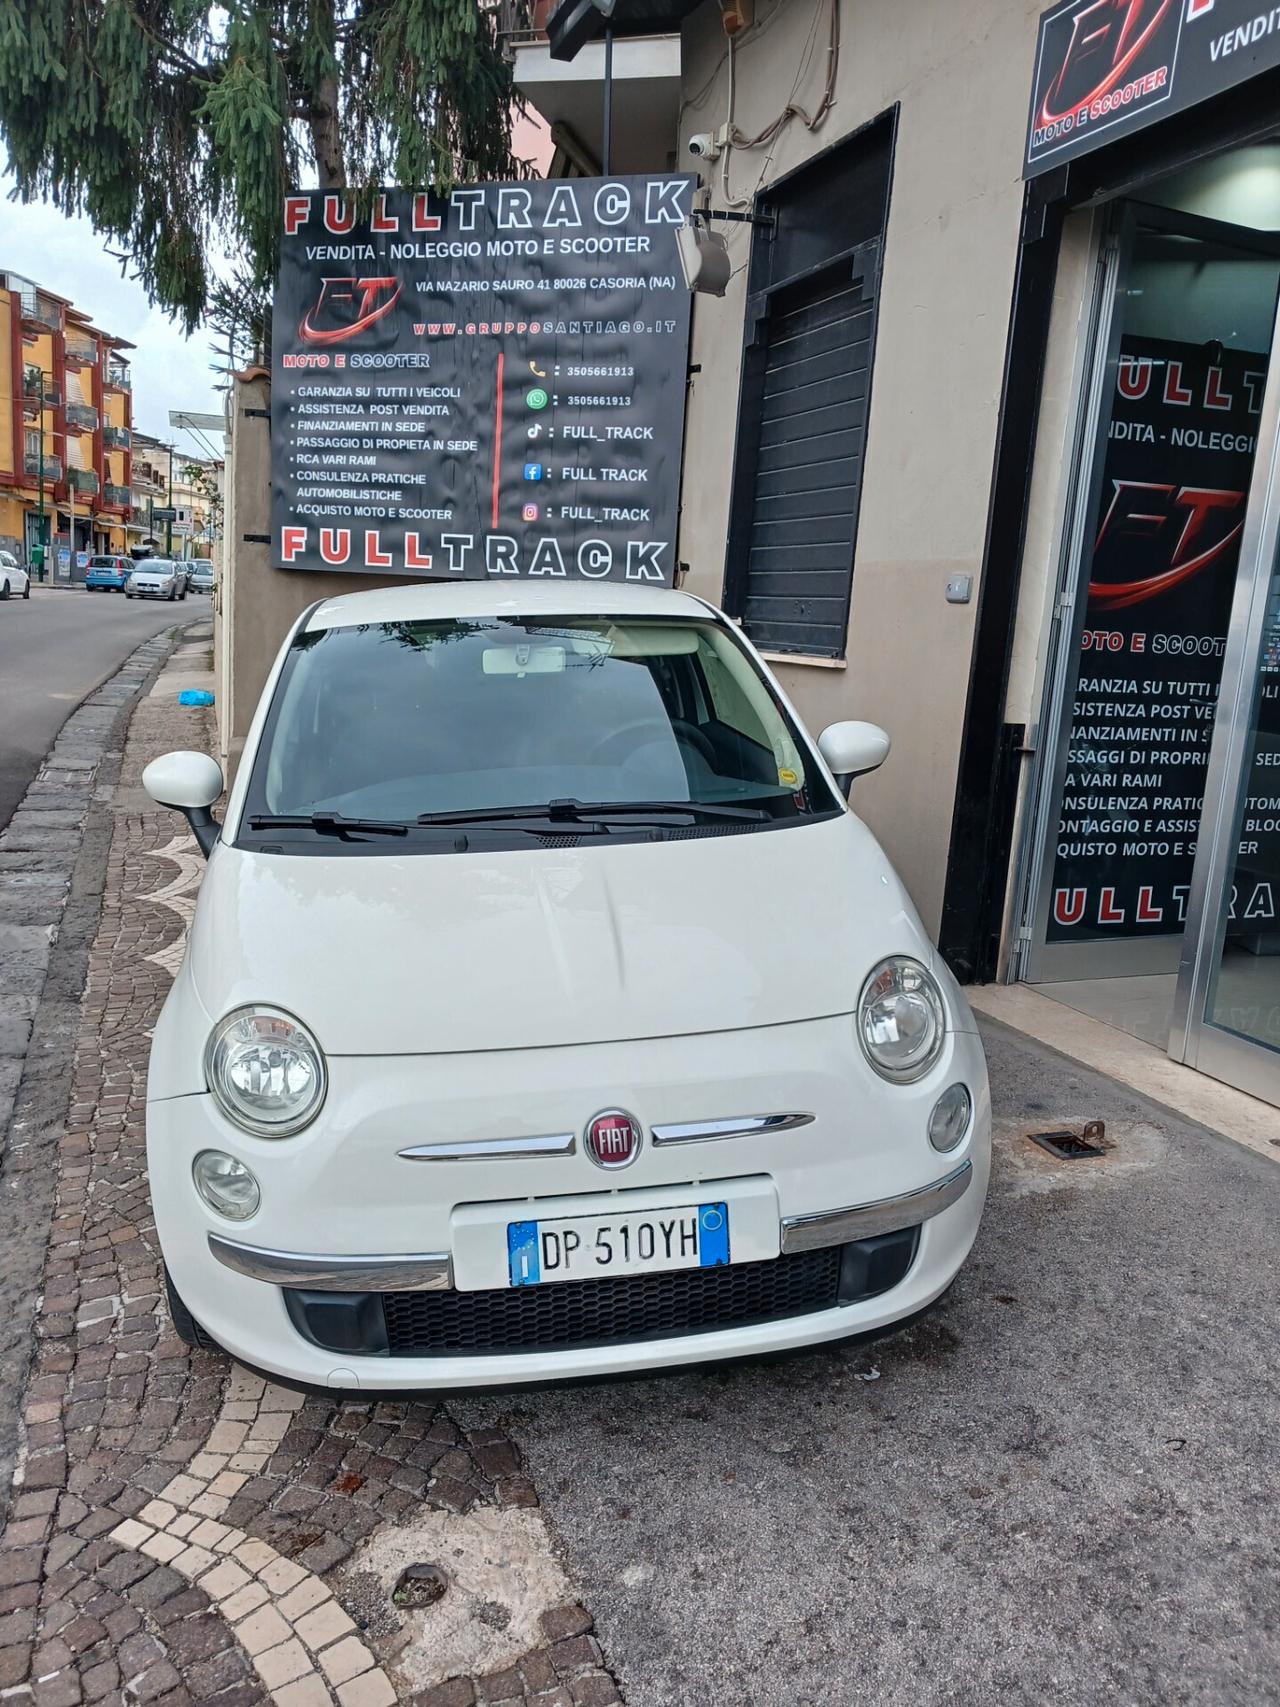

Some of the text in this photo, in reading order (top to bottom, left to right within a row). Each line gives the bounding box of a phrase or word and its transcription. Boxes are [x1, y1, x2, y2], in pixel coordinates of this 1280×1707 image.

[1033, 66, 1168, 147] MOTO E SCOOTER
[306, 245, 375, 260] VENDITA
[390, 242, 481, 259] NOLEGGIO
[486, 240, 538, 257] MOTO
[544, 239, 554, 255] E
[560, 236, 650, 254] SCOOTER
[416, 276, 676, 292] VIA NAZARIO SAURO 41 80026 CASORIA (NA)
[413, 320, 676, 336] WWW.GRUPPOSANTIAGO.IT
[283, 353, 430, 368] MOTO E SCOOTER
[298, 387, 461, 398] GARANZIA SU TUTTI I VEICOLI
[298, 404, 450, 416] ASSISTENZA POST VENDITA
[297, 421, 425, 433] FINANZIAMENTI IN SEDE
[563, 426, 653, 442] FULL_TRACK
[297, 438, 478, 451] PASSAGGIO DI PROPIETA IN SEDE
[297, 454, 377, 466] RCA VARI RAMI
[297, 471, 427, 485] CONSULENZA PRATICHE
[562, 468, 597, 480] FULL
[600, 468, 648, 482] TRACK
[297, 488, 402, 501] AUTOMOBILISTICHE
[296, 505, 453, 520] ACQUISTO MOTO E SCOOTER
[561, 506, 650, 523] FULL_TRACK
[1130, 633, 1146, 653] E
[1075, 678, 1138, 694] RANZIA
[1142, 680, 1163, 695] SU
[1168, 682, 1211, 696] TUTTI
[1150, 704, 1191, 719] POST
[1180, 729, 1198, 742] IN
[1068, 750, 1125, 764] SSAGGI
[1130, 751, 1146, 764] DI
[1080, 774, 1117, 787] VARI
[1122, 774, 1162, 788] RAMI
[1062, 797, 1148, 810] NSULENZA
[1144, 820, 1153, 833] E
[1156, 820, 1200, 833] ASSIS
[1057, 843, 1117, 859] QUISTO
[1122, 842, 1170, 856] MOTO
[1173, 842, 1184, 856] E
[598, 1127, 630, 1154] FIAT
[542, 1218, 698, 1270] DP 510YH
